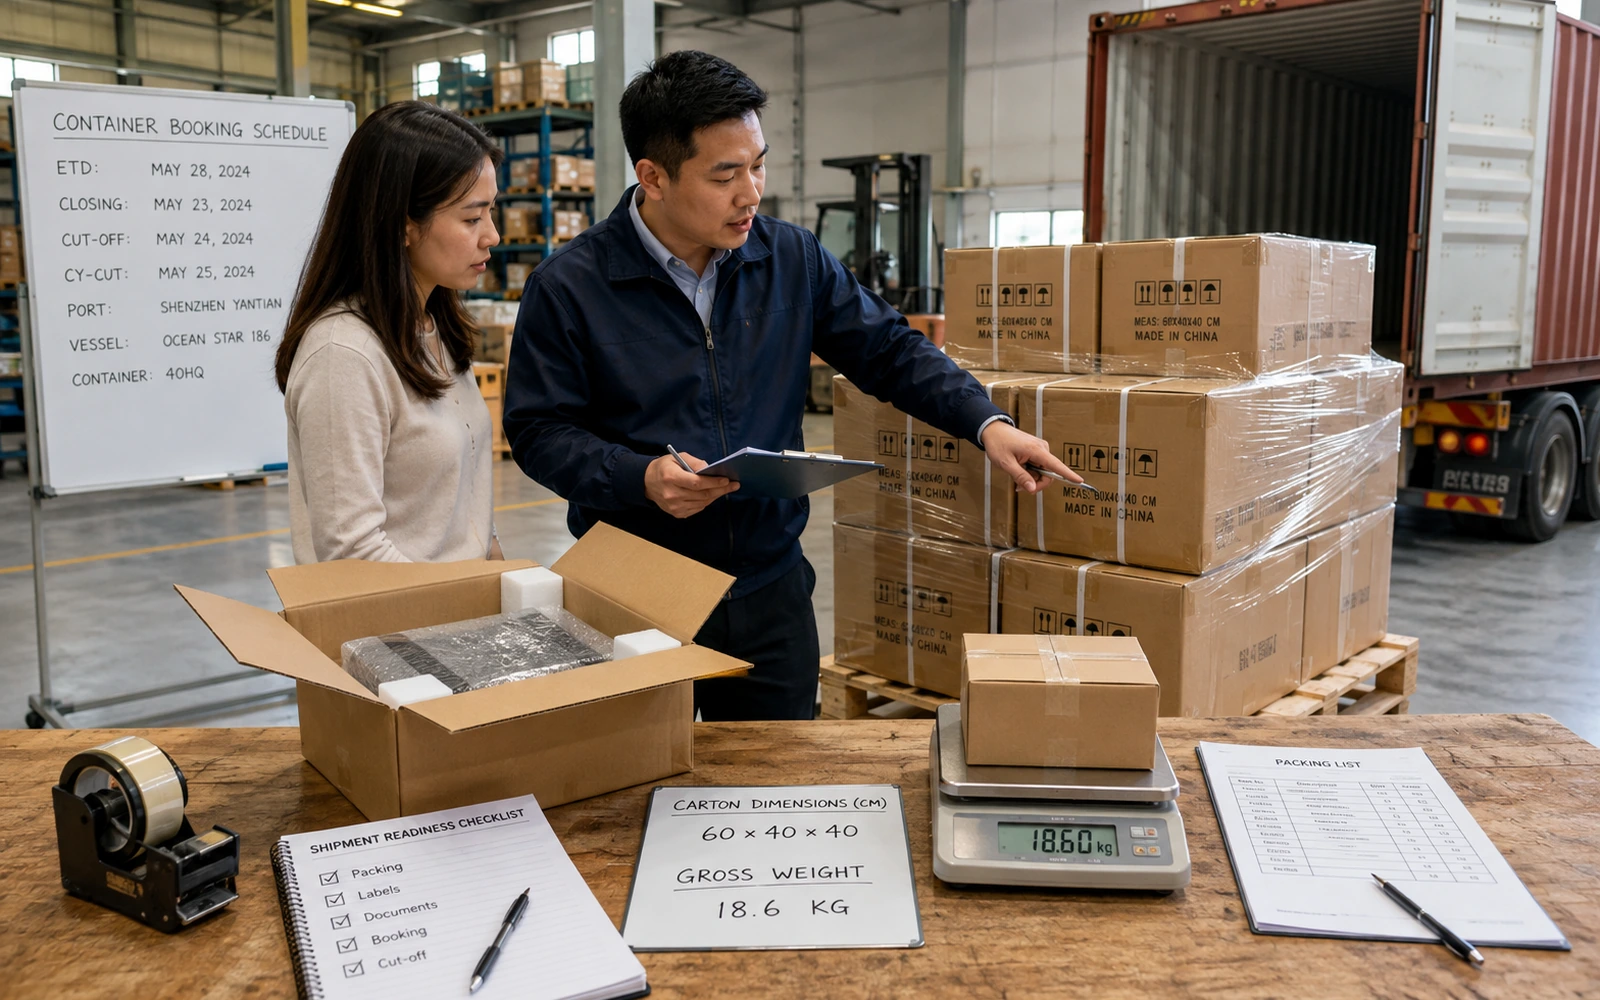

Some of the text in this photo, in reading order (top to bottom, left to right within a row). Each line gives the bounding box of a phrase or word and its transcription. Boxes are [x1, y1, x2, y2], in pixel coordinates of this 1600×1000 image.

[53, 112, 327, 141] CONTAINER BOOKING SCHEDULE
[57, 160, 250, 179] ETD: MAY 28, 2024
[59, 197, 252, 213] CLOSING: MAY 23, 2024
[62, 232, 253, 247] CUT-OFF: MAY 24, 2024
[64, 265, 255, 282] CY-CUT: MAY 25, 2024
[67, 298, 282, 317] PORT: SHENZHEN YANTIAN
[1134, 316, 1160, 326] MEAS:
[1206, 317, 1220, 327] CM
[69, 330, 271, 352] VESSEL: OCEAN STAR 186
[1007, 330, 1017, 339] IN
[1020, 329, 1051, 340] CHINA
[1135, 330, 1218, 342] MADE IN CHINA
[72, 366, 205, 387] CONTAINER: 40HQ
[946, 475, 960, 486] CM
[925, 487, 957, 501] CHINA
[1142, 495, 1157, 507] CM
[1064, 502, 1155, 523] MADE IN CHINA
[876, 629, 900, 644] MADE
[917, 639, 948, 656] CHINA
[1275, 758, 1361, 769] PACKING LIST
[673, 797, 888, 811] CARTON DIMENSIONS (CM)
[310, 808, 525, 854] SHIPMENT READINESS CHECKLIST
[702, 826, 735, 842] 60
[764, 825, 797, 840] 40
[825, 824, 859, 839] 40
[1032, 828, 1113, 857] 18.60 kg
[351, 861, 404, 879] Packing
[676, 865, 865, 884] GROSS WEIGHT
[358, 884, 401, 900] Labels
[364, 900, 438, 922] Documents
[718, 899, 850, 919] 18.6 KG
[371, 926, 428, 946] Booking
[377, 949, 428, 969] Cut-off
